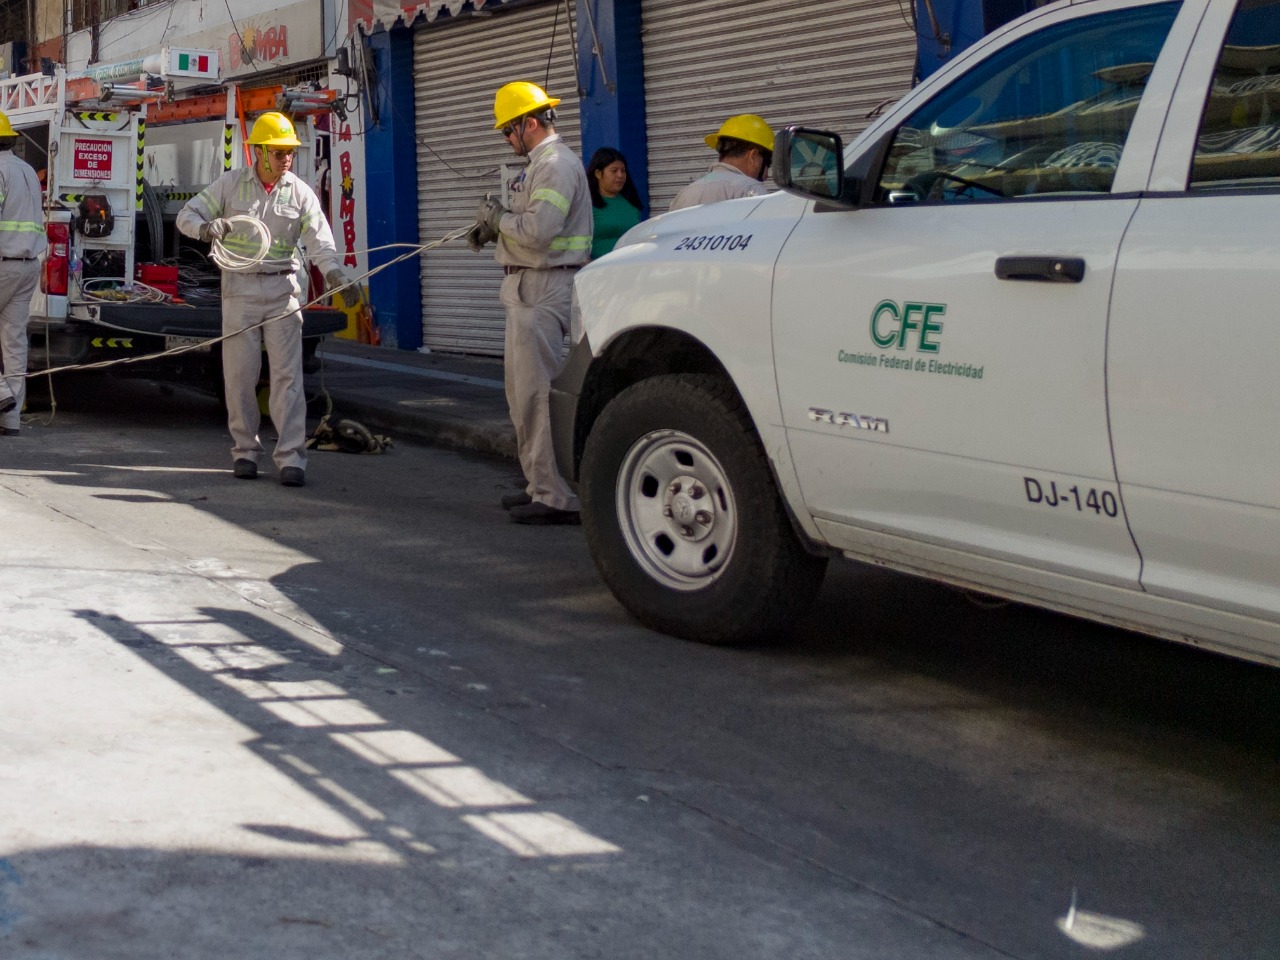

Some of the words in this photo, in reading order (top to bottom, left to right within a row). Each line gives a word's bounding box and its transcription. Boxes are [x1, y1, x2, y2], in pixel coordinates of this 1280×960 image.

[229, 24, 289, 70] BOMBA
[75, 142, 112, 152] PRECAUCIÓN
[78, 152, 108, 161] EXCESO
[74, 169, 111, 178] DIMENSIONES
[87, 160, 98, 168] DE
[674, 234, 753, 251] 24310104
[869, 299, 947, 354] CFE
[838, 349, 877, 367] Comisión
[878, 354, 913, 371] Federal
[914, 358, 926, 372] de
[928, 359, 984, 379] Electricidad
[808, 407, 889, 433] RAM
[1023, 476, 1118, 518] DJ-140
